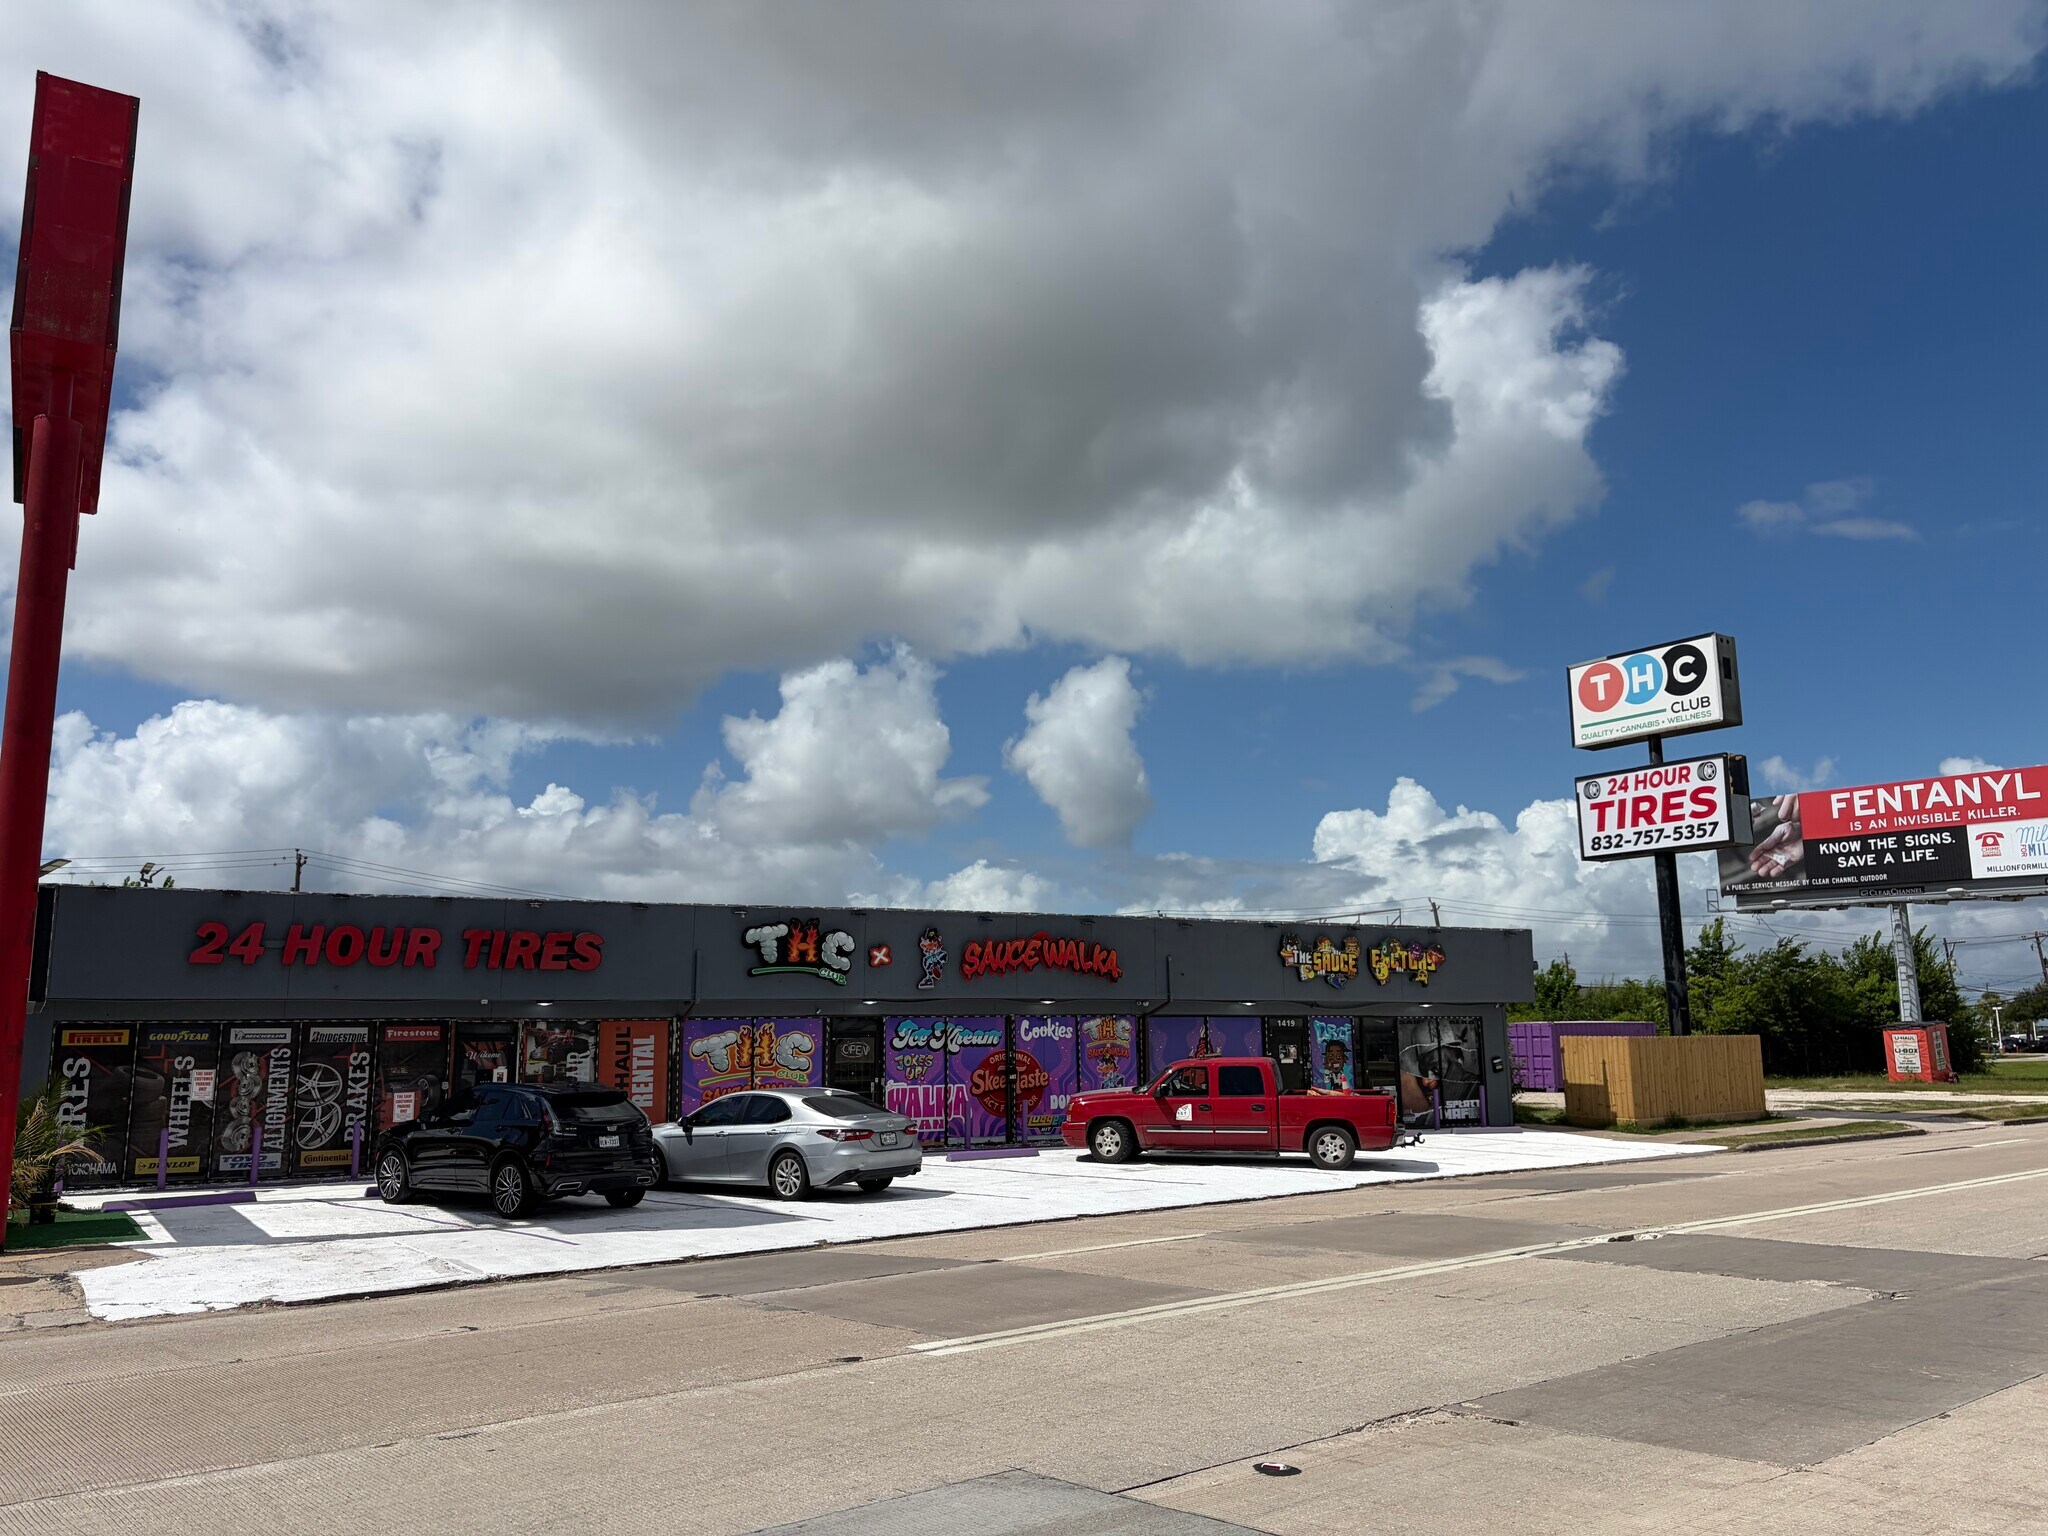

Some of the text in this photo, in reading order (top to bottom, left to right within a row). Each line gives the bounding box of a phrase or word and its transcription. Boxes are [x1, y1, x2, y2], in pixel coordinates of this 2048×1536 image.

[1588, 654, 1699, 702] THC
[1670, 696, 1711, 714] CLUB
[1581, 710, 1712, 741] QUALITY CANNABIS WELLNESS
[1607, 765, 1691, 796] 24 HOUR
[1830, 772, 2041, 819] FENTANYL
[1590, 786, 1718, 833] TIRES
[1850, 806, 2021, 832] IS AN INVISIBLE KILLER.
[1591, 821, 1720, 851] 832-757-5357
[1819, 832, 1956, 855] KNOW THE SIGNS.
[1837, 848, 1939, 868] SAVE A LIFE.
[2020, 844, 2028, 858] FOR
[1731, 883, 1750, 891] PUBLIC
[1751, 881, 1774, 889] SERVICE
[1775, 879, 1801, 888] MESSAGE
[1811, 877, 1830, 885] CLEAR
[1831, 876, 1858, 884] CHANNEL
[1860, 873, 1888, 882] OUTDOOR
[187, 921, 606, 972] 24 HOUR TIRES
[744, 918, 856, 971] THC
[1293, 949, 1313, 964] THE
[1312, 952, 1358, 974] SAUCE
[819, 967, 848, 987] CLUB
[386, 1029, 440, 1039] Firestone
[1020, 1017, 1074, 1042] Cookies
[1081, 1016, 1132, 1042] THC
[1277, 1019, 1296, 1027] 1419
[68, 1032, 124, 1044] PIRELLI
[149, 1031, 210, 1043] GOODYEAR
[244, 1032, 287, 1040] MICHELIN
[311, 1031, 367, 1042] BRIDGESTONE
[691, 1022, 815, 1073] THC
[842, 1042, 871, 1056] OPEN
[631, 1034, 655, 1108] RENTAL
[263, 1047, 292, 1150] ALIGNMENTS
[303, 1154, 350, 1164] Continental
